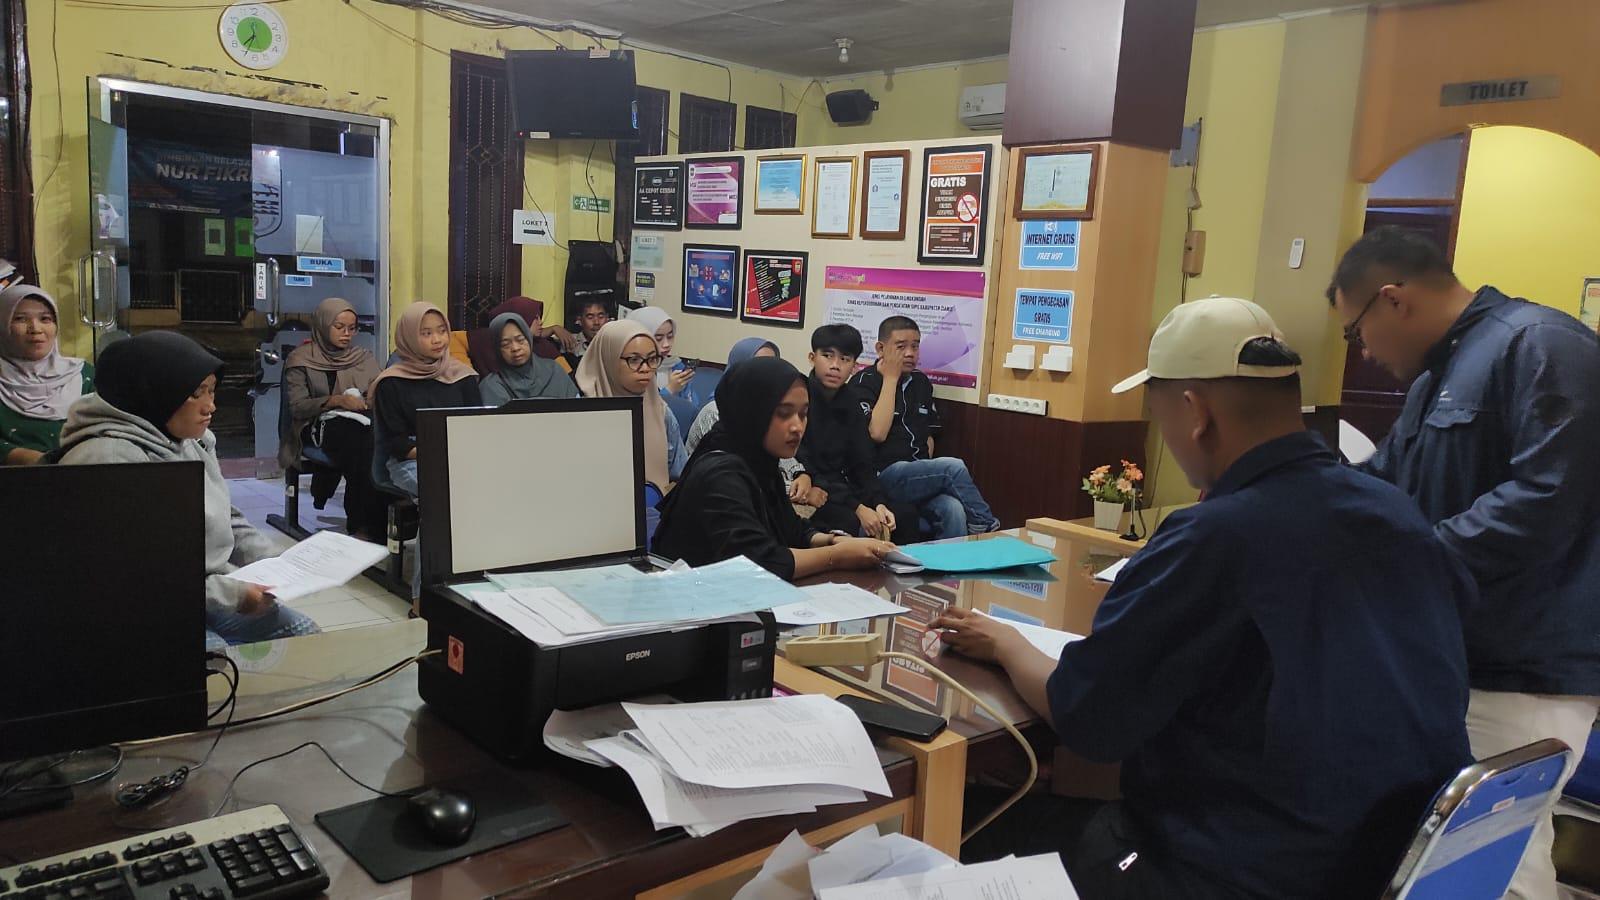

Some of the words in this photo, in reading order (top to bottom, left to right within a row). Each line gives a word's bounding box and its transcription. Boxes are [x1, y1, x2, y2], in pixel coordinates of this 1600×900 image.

[1469, 80, 1528, 99] TOILET
[157, 163, 198, 180] NUR
[203, 166, 252, 182] FIKR
[930, 176, 967, 188] GRATIS
[1025, 233, 1053, 245] INTERNET
[1054, 233, 1075, 245] GRATIS
[310, 258, 333, 266] BUKA
[1036, 252, 1050, 260] FREE
[1020, 294, 1037, 305] TEMPAT
[1037, 295, 1069, 308] PENGECASAN
[1034, 312, 1051, 323] GRATIS
[1022, 326, 1035, 335] FREE
[625, 649, 651, 662] EPSON
